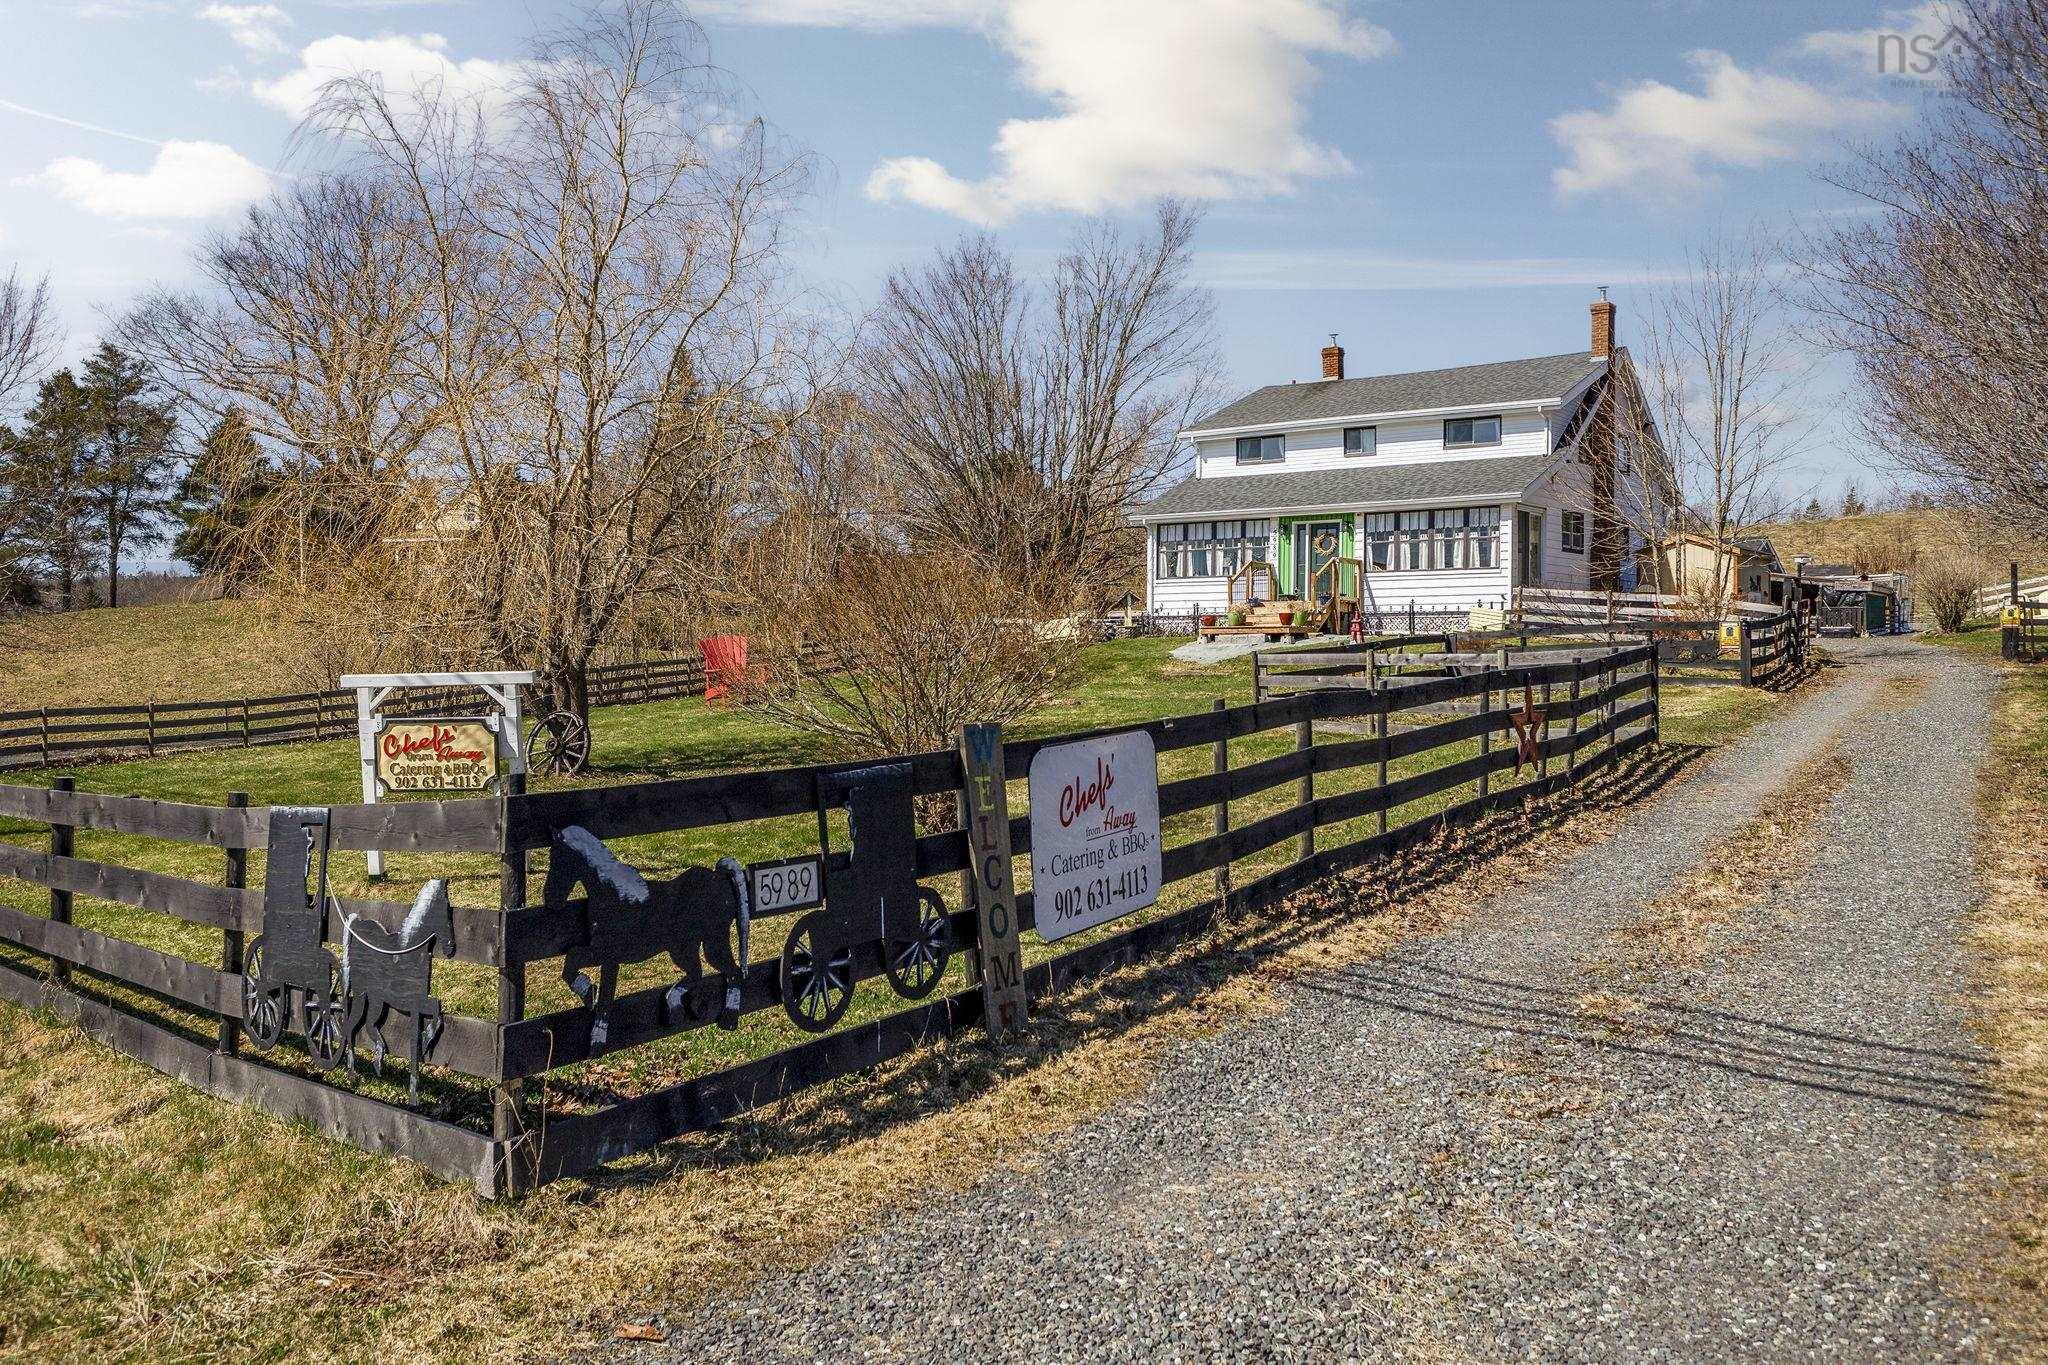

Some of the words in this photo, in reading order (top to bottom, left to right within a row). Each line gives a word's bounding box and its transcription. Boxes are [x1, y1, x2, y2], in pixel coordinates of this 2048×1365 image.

[389, 762, 441, 779] Catering
[436, 745, 486, 762] Away
[394, 776, 419, 789] 902
[421, 776, 481, 789] 631-4113
[1085, 825, 1101, 839] from
[1103, 805, 1137, 835] Away
[1051, 847, 1104, 877] Catering
[1107, 839, 1119, 860] &
[1121, 831, 1150, 856] BBQs
[760, 866, 812, 906] 5989
[1054, 886, 1083, 924] 902
[1087, 864, 1149, 913] 631-4113
